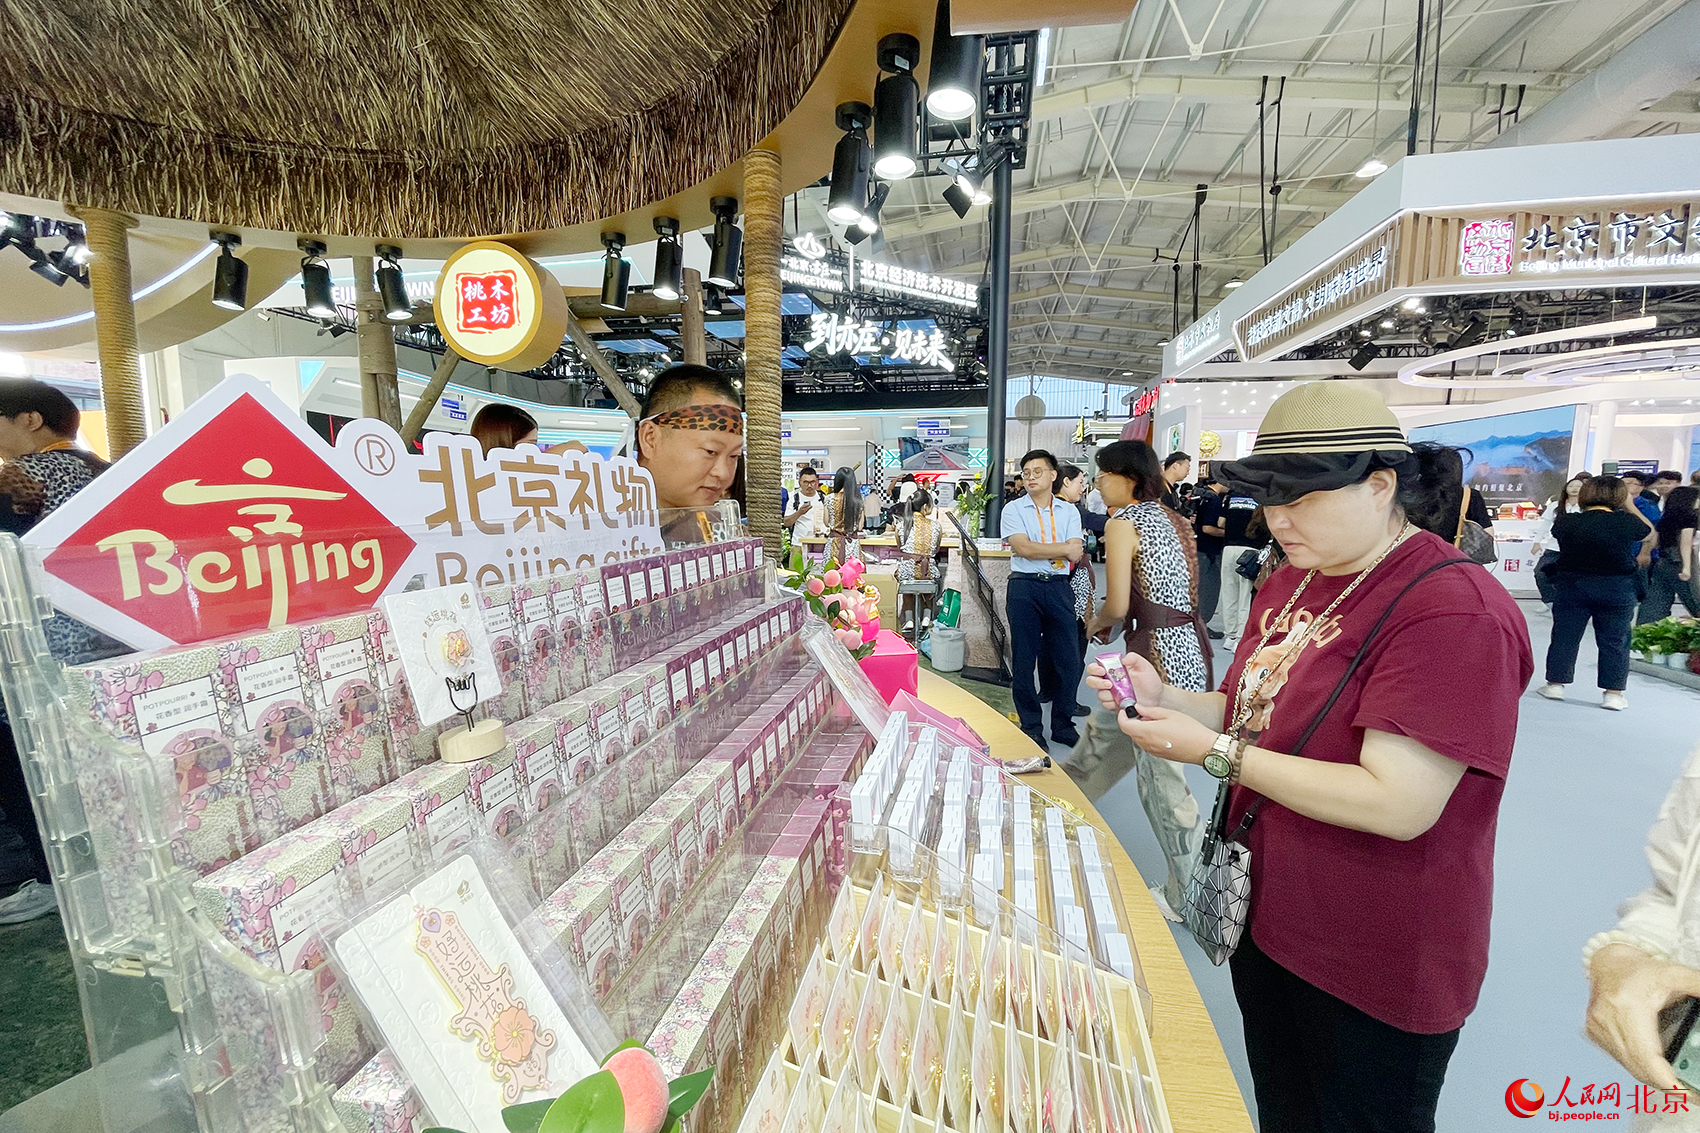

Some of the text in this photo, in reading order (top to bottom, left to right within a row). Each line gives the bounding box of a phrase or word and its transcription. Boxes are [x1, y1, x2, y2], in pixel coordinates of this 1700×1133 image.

[1519, 260, 1560, 274] Beijing
[1562, 256, 1620, 271] Municipal
[1621, 253, 1669, 268] Cultural
[860, 259, 979, 301] 北京经济技术开发区
[466, 303, 510, 324] 工坊
[418, 446, 655, 537] 北京礼物
[96, 529, 384, 630] Beijing
[243, 668, 279, 682] POTPOURRI
[253, 680, 274, 691] 花香型
[142, 694, 188, 711] POTPOURRI
[155, 708, 182, 720] 花香型
